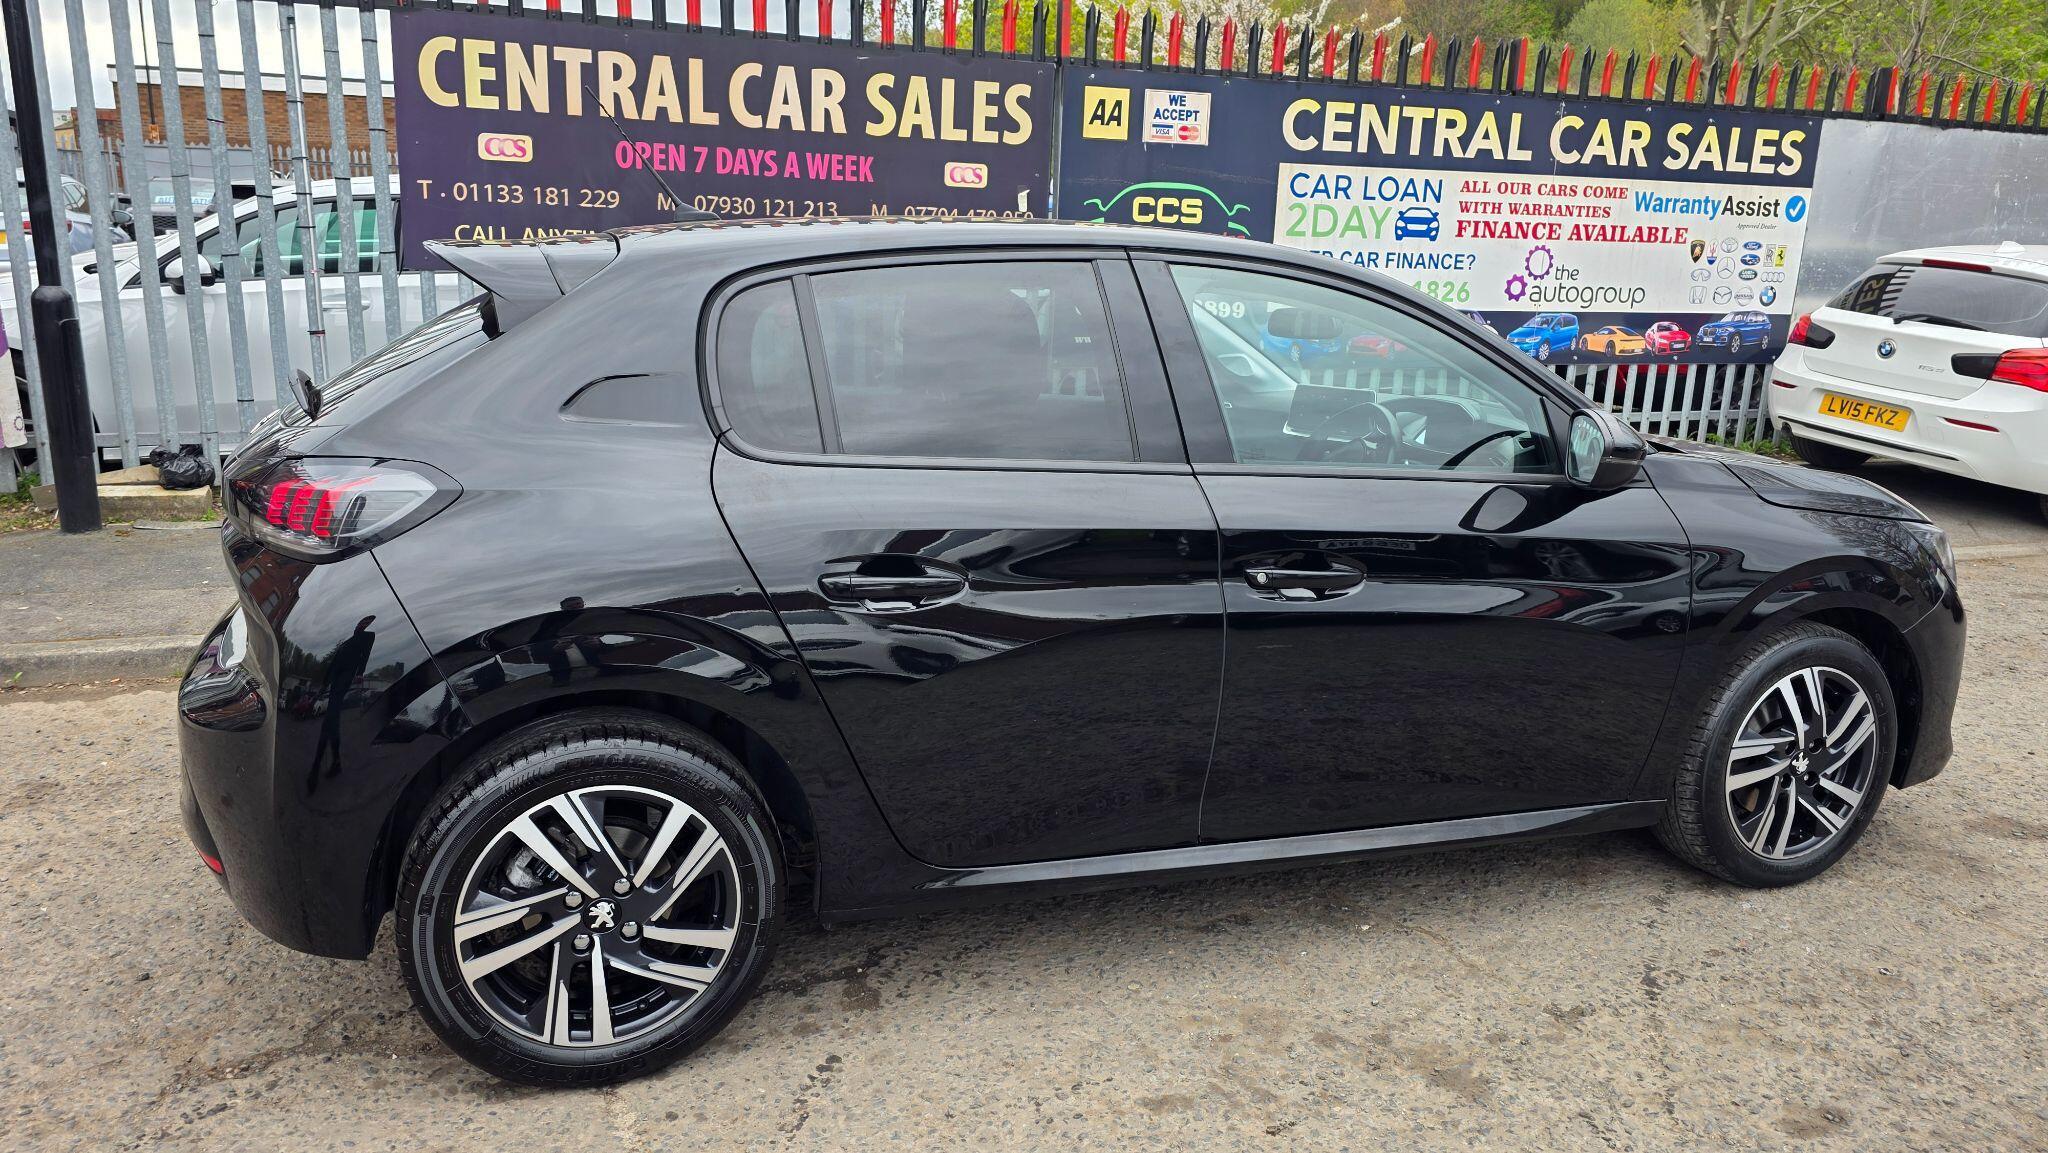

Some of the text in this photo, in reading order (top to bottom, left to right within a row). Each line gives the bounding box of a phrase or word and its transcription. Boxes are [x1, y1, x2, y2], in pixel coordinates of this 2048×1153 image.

[418, 36, 1033, 145] CENTRAL CAR SALES
[1169, 94, 1187, 107] WE
[1089, 99, 1123, 127] AA
[1153, 108, 1200, 122] ACCEPT
[484, 137, 527, 158] CCS
[1282, 98, 1807, 176] CENTRAL CAR SALES
[615, 140, 874, 183] OPEN 7 DAYS A WEEK
[453, 182, 524, 204] 01133
[533, 186, 569, 207] 181
[578, 189, 620, 209] 229
[1289, 172, 1443, 204] CAR LOAN
[1460, 180, 1629, 200] ALL OUR CARS COME
[694, 195, 756, 215] 07930
[763, 199, 794, 217] 121
[803, 201, 838, 217] 213
[1132, 196, 1203, 224] CCS
[1459, 200, 1612, 219] WITH WARRANTIES
[1285, 203, 1393, 240] 2DAY
[1455, 219, 1689, 245] FINANCE AVAILABLE
[1340, 250, 1380, 268] CAR
[1385, 251, 1476, 271] FINANCE?
[1555, 264, 1580, 281] the
[1529, 282, 1646, 310] autogroup
[1194, 300, 1246, 319] 899
[1827, 397, 1900, 426] LV15 FKZ
